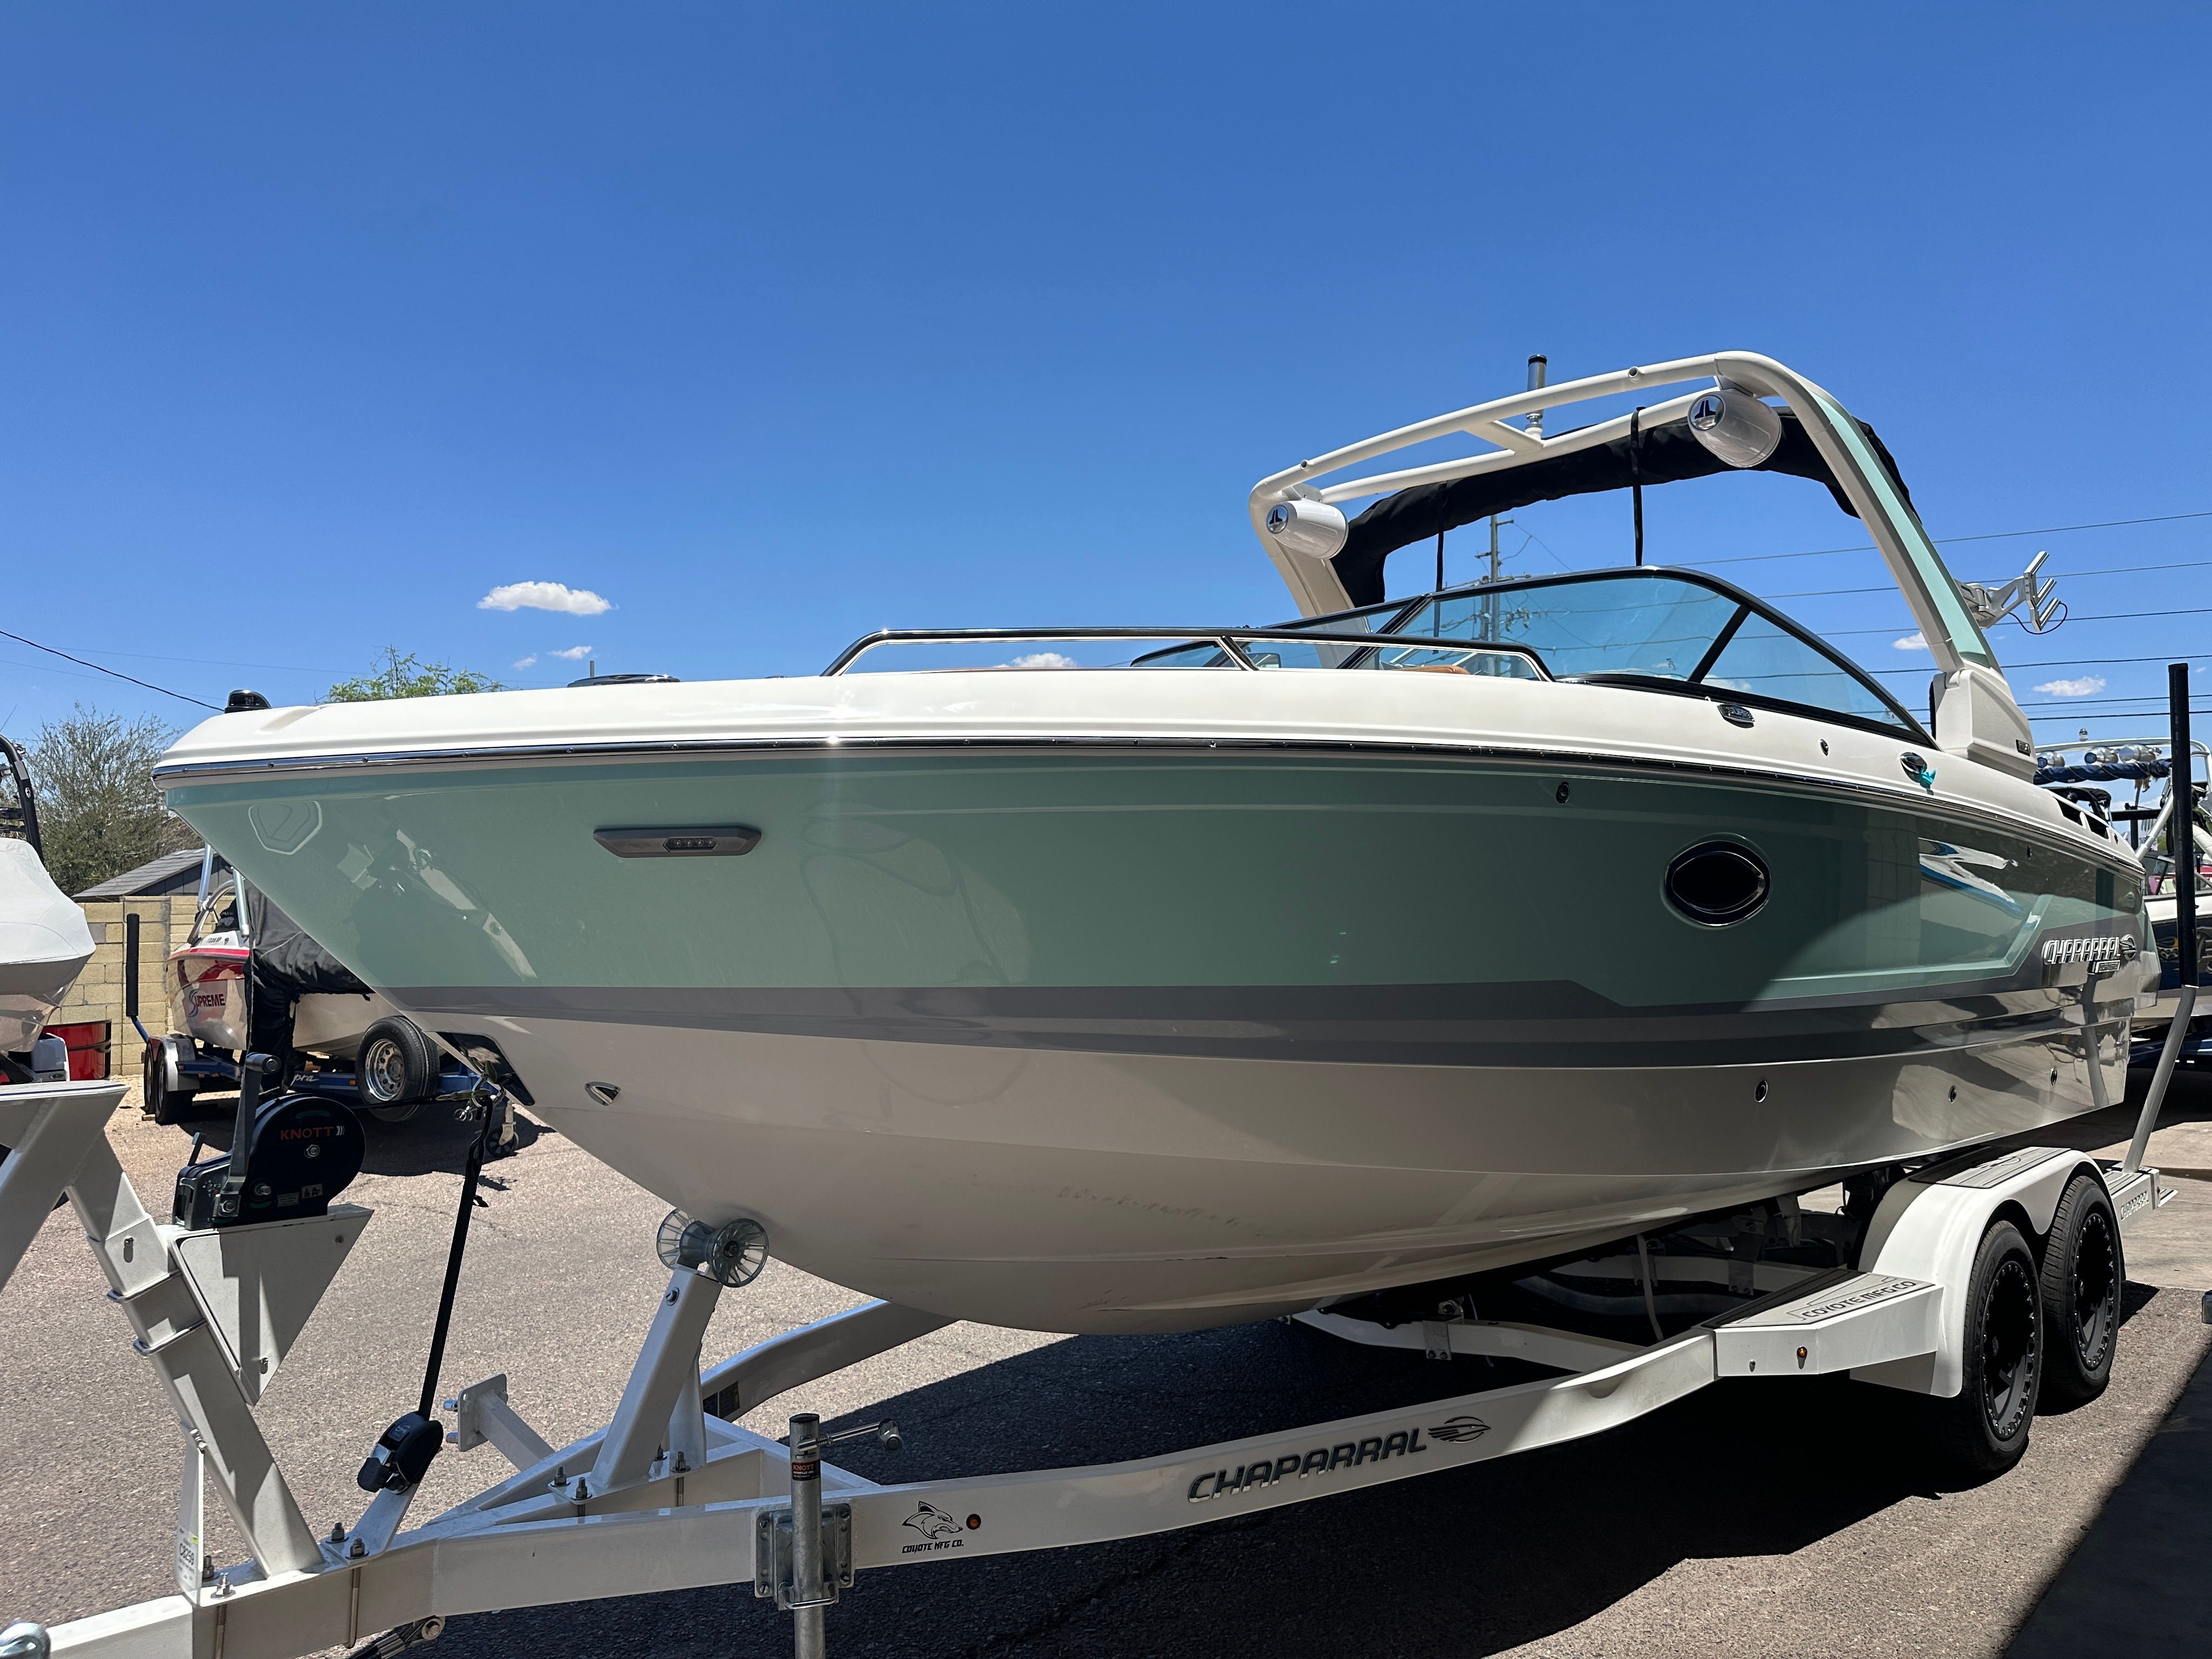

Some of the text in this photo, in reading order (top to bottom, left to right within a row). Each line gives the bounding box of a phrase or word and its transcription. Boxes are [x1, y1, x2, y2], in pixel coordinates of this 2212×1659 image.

[2041, 937, 2121, 964] CHAPARRAL
[188, 989, 225, 1017] SUPREME
[290, 1074, 319, 1086] pra
[280, 1126, 334, 1140] KNOTT
[1802, 1281, 1917, 1318] COYOTE MFG CO
[1188, 1427, 1427, 1503] CHAPARRAL
[902, 1543, 933, 1554] COYOTE
[934, 1541, 951, 1550] MFG
